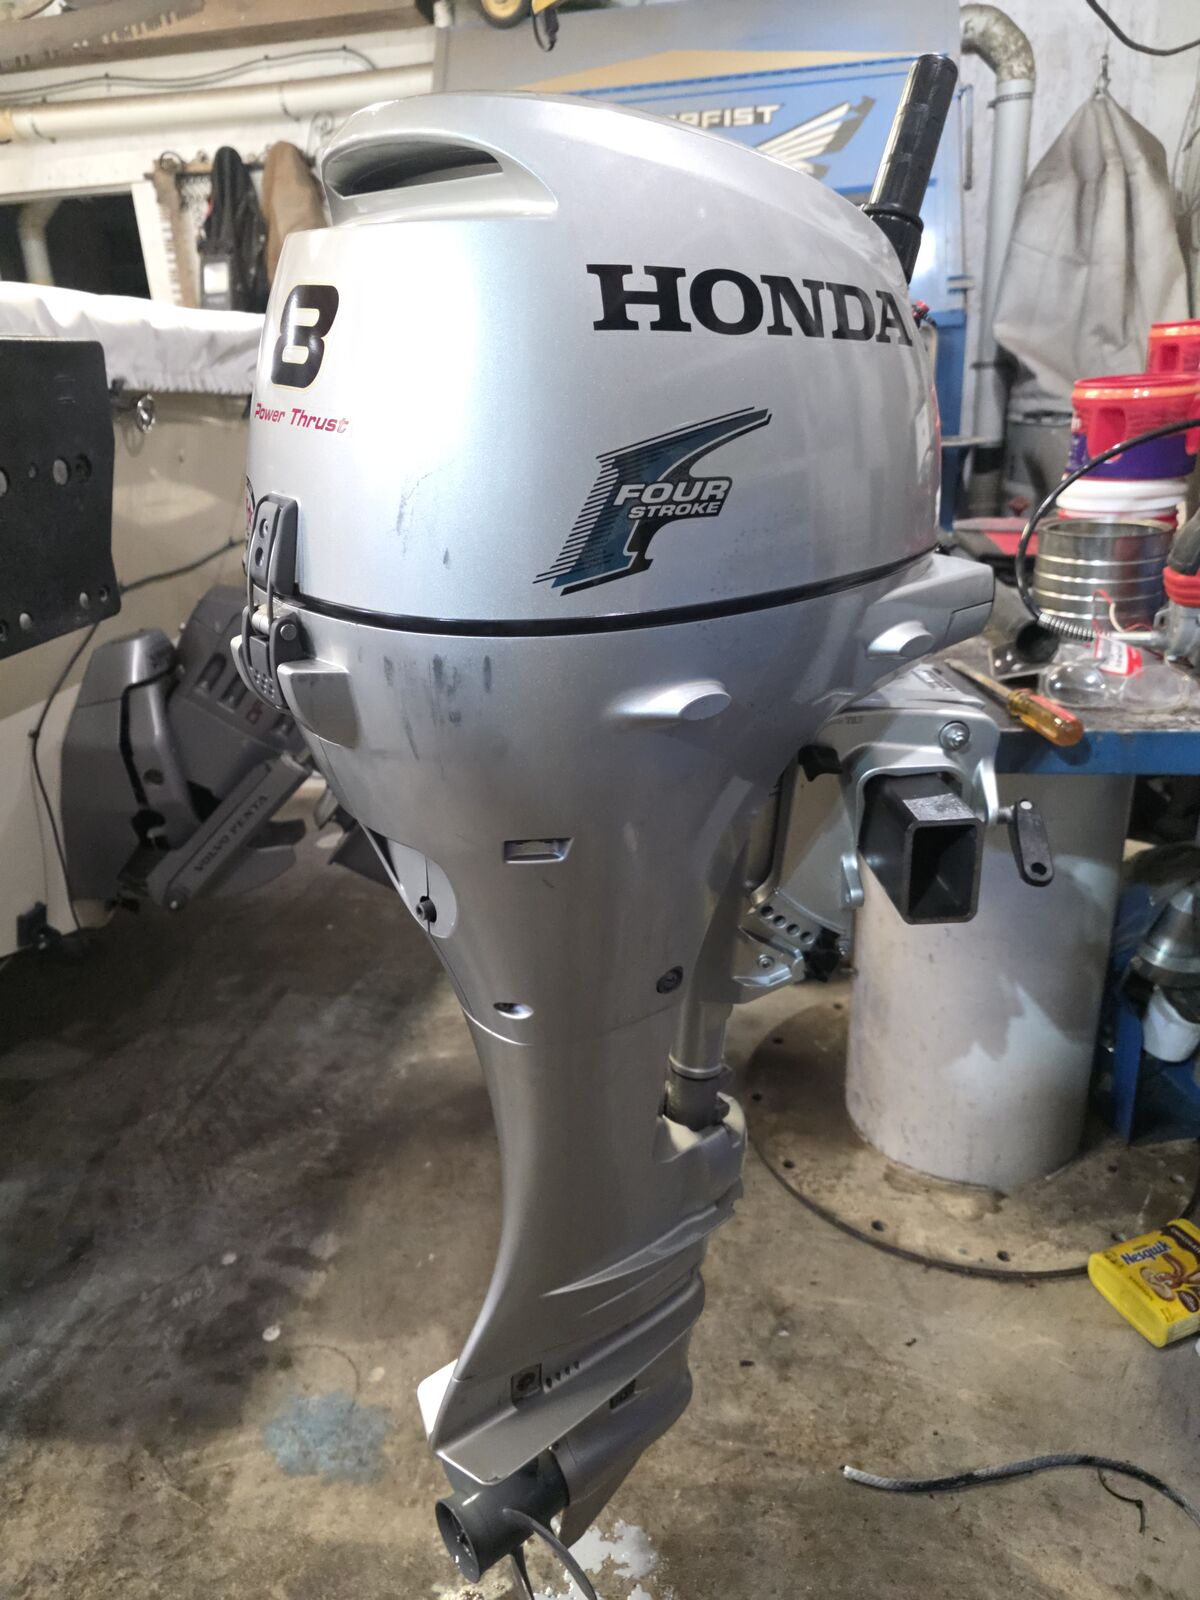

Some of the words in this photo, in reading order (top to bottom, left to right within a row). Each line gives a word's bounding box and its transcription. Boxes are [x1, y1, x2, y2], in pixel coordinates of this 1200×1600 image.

[586, 263, 912, 346] HONDA
[270, 284, 340, 389] 8
[254, 402, 286, 423] Power
[290, 408, 349, 434] Thrust
[613, 480, 730, 506] FOUR
[628, 501, 721, 519] STROKE
[1120, 1240, 1172, 1266] Nesquik
